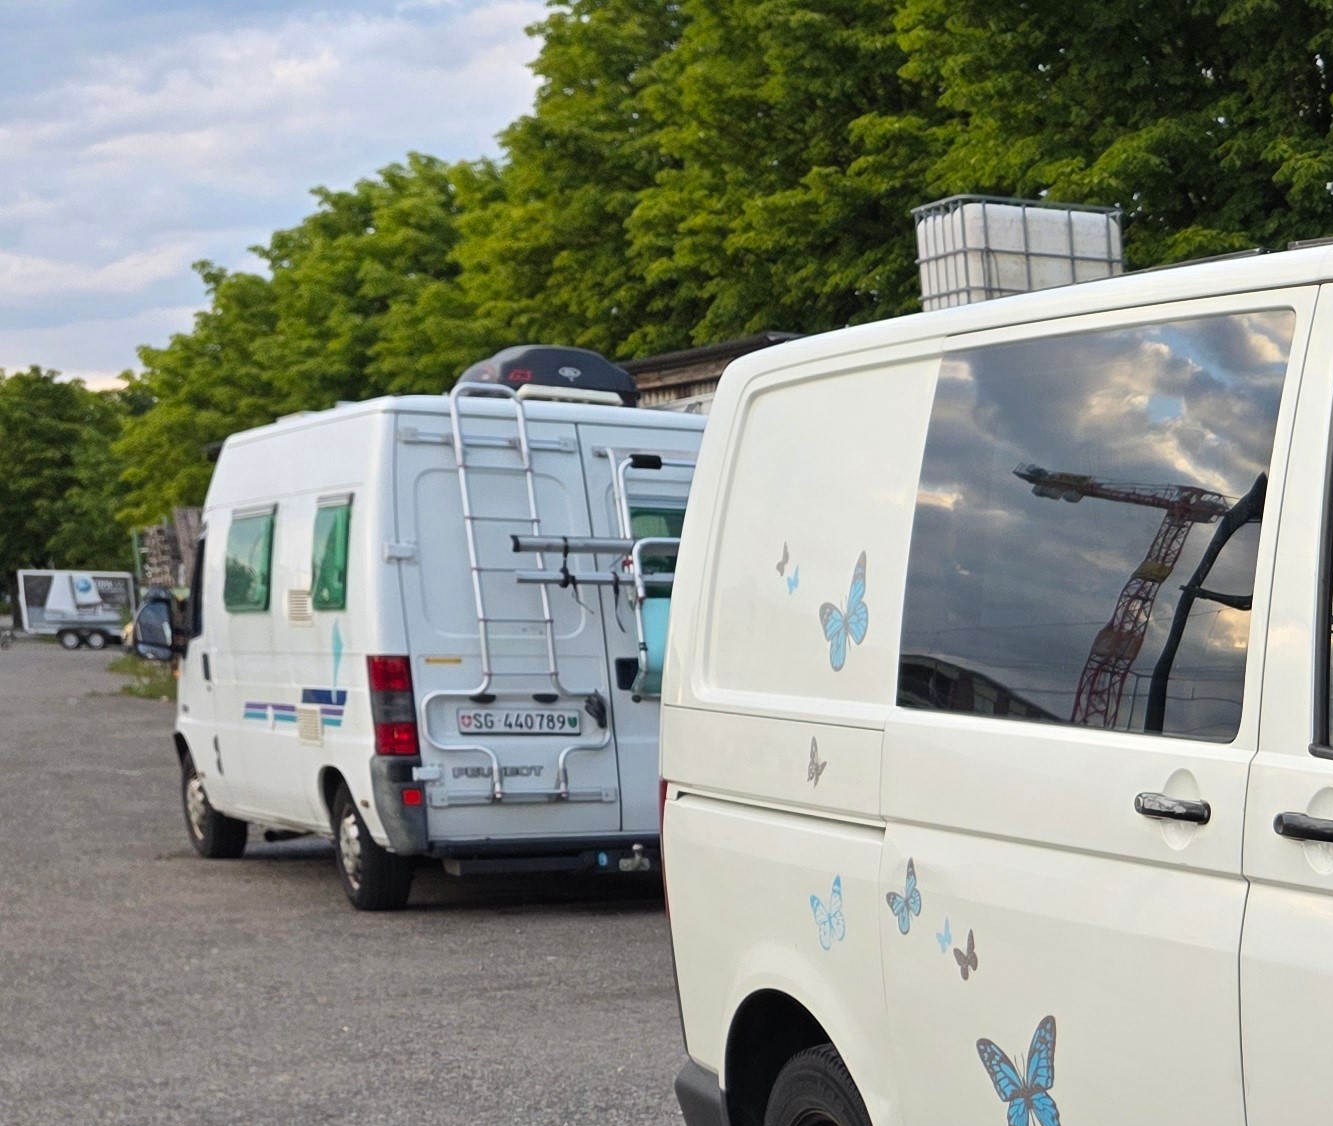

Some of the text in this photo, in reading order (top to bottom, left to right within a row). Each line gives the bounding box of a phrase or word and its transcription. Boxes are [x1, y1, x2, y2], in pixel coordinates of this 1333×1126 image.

[472, 712, 566, 730] SG 440789
[452, 765, 544, 779] PEUEOT
